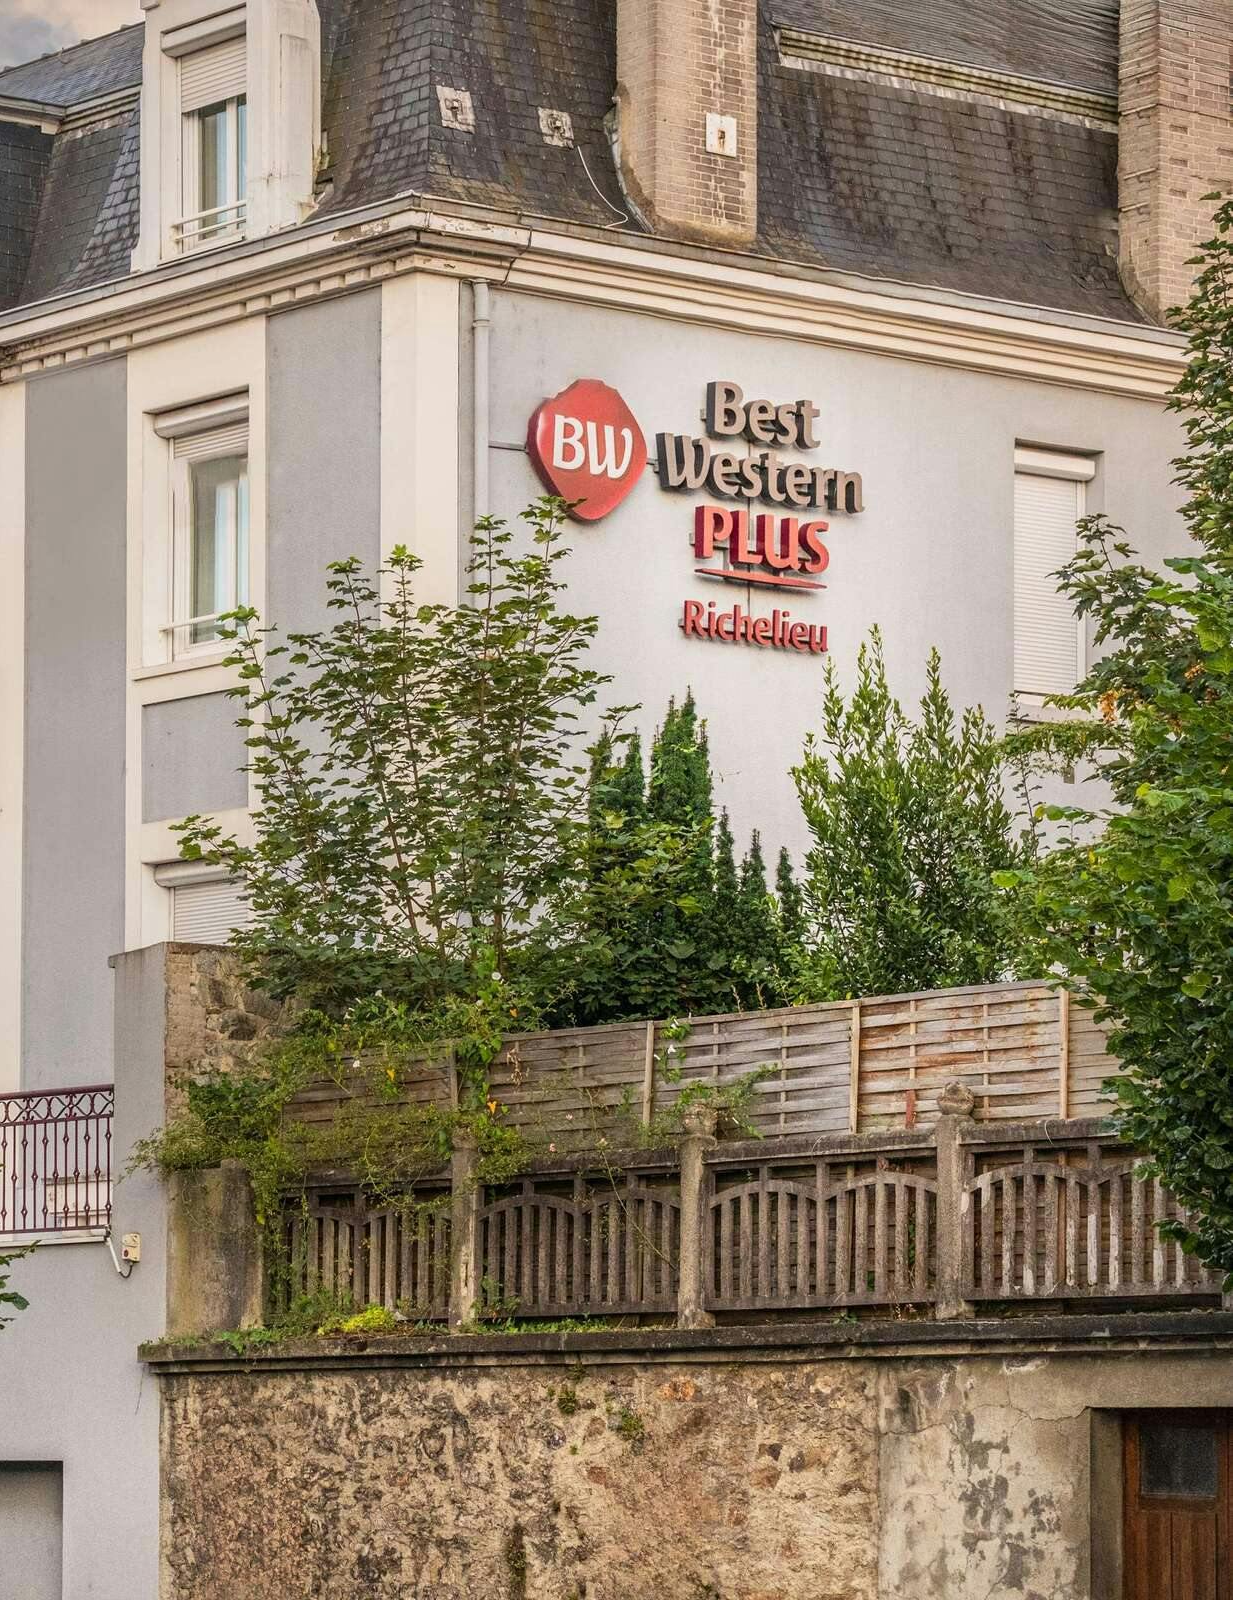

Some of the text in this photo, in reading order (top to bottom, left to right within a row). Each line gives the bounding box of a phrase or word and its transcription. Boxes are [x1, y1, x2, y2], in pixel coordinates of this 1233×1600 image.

[552, 414, 633, 479] BW
[706, 381, 821, 449] Best
[655, 432, 865, 513] Western
[694, 504, 830, 574] PLUS
[683, 600, 828, 653] Richelieu
